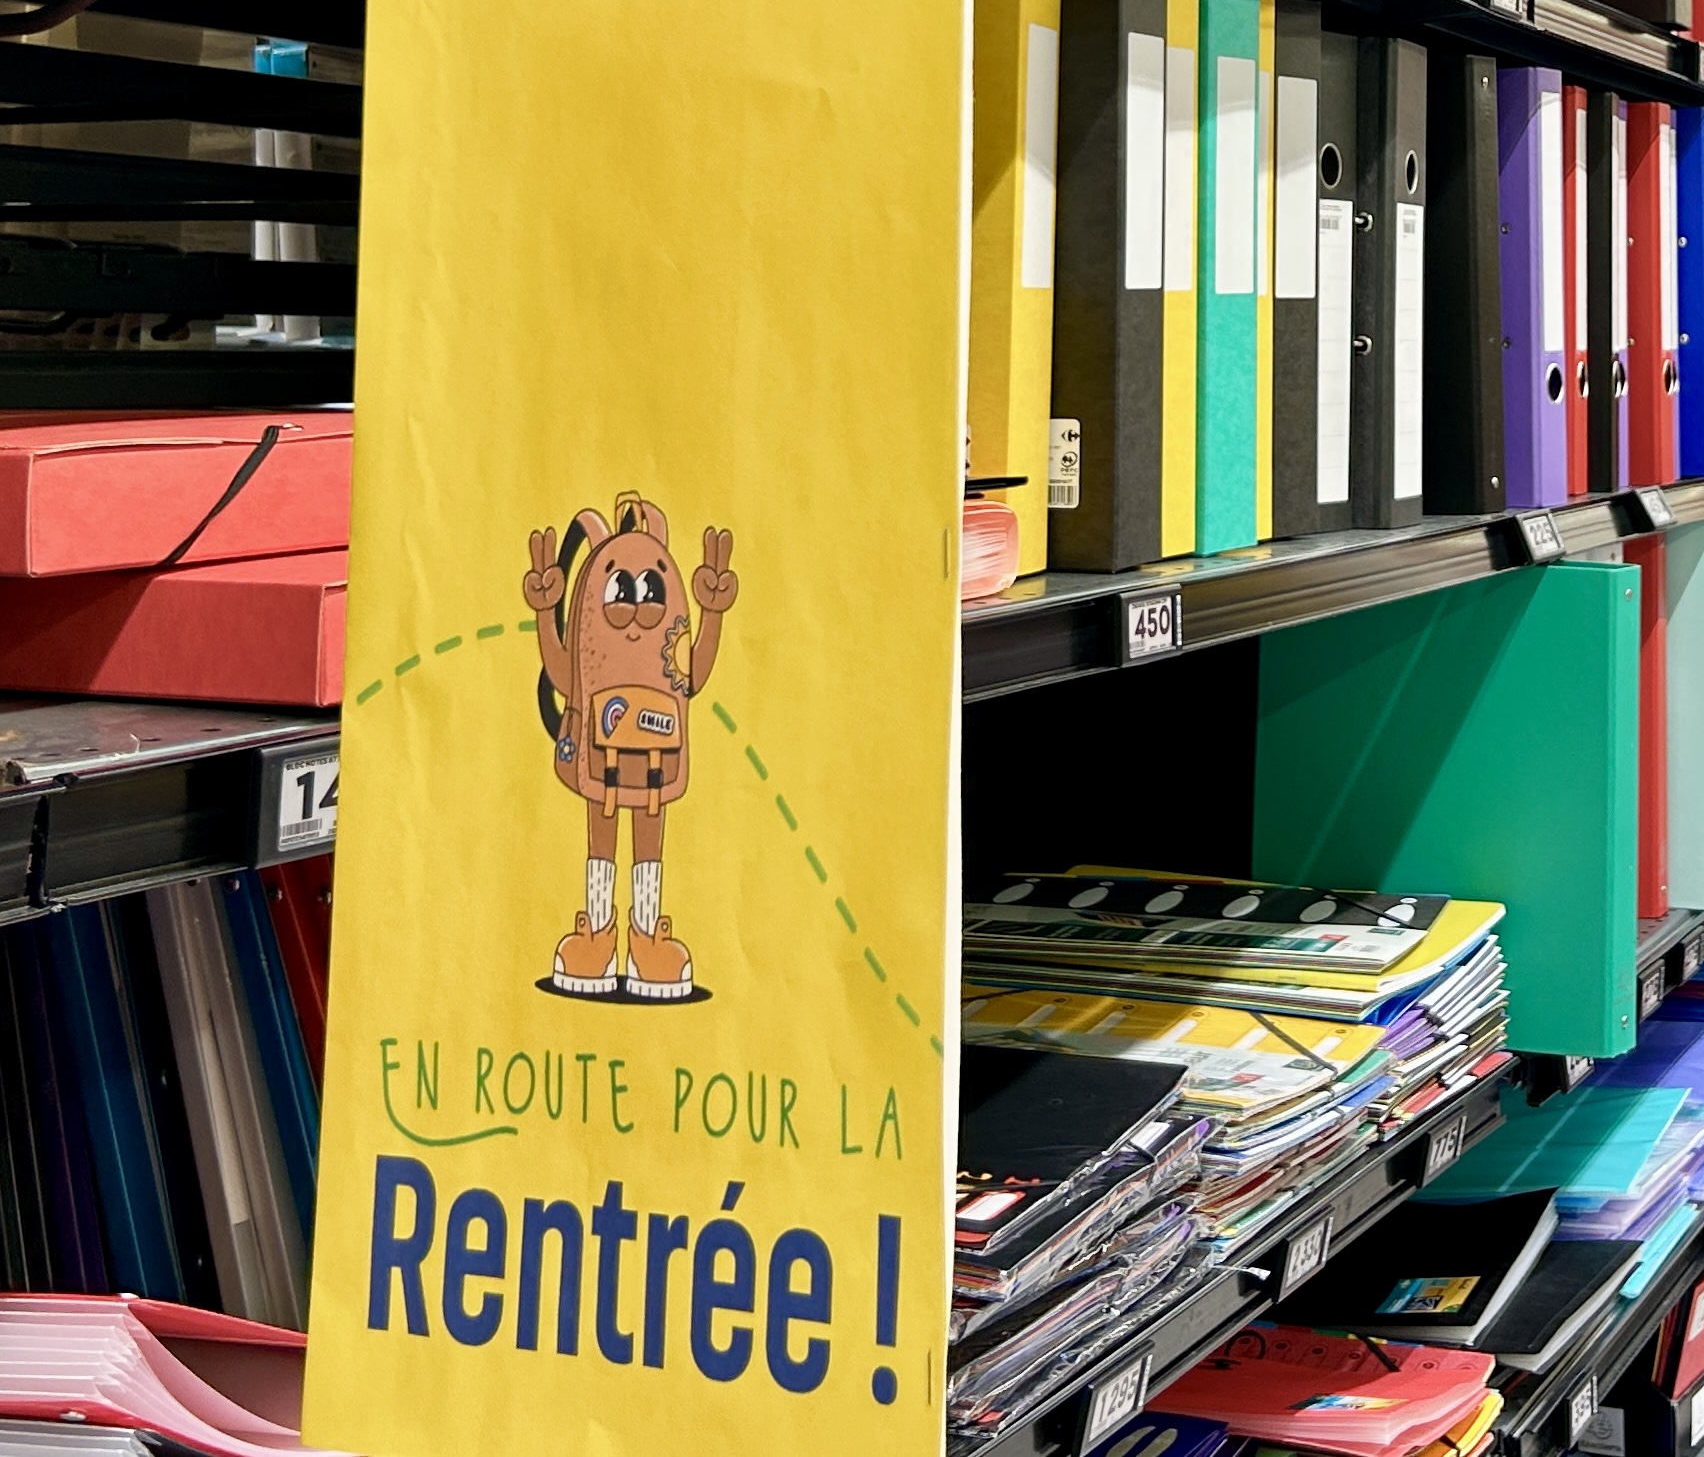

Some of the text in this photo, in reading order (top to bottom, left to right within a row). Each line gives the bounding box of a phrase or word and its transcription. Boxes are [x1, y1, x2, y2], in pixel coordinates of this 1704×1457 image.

[1134, 604, 1170, 640] 450
[475, 1046, 635, 1135] ROUTE
[673, 1067, 800, 1149] POUR
[839, 1083, 902, 1160] LA
[367, 1154, 902, 1406] Rentrée !
